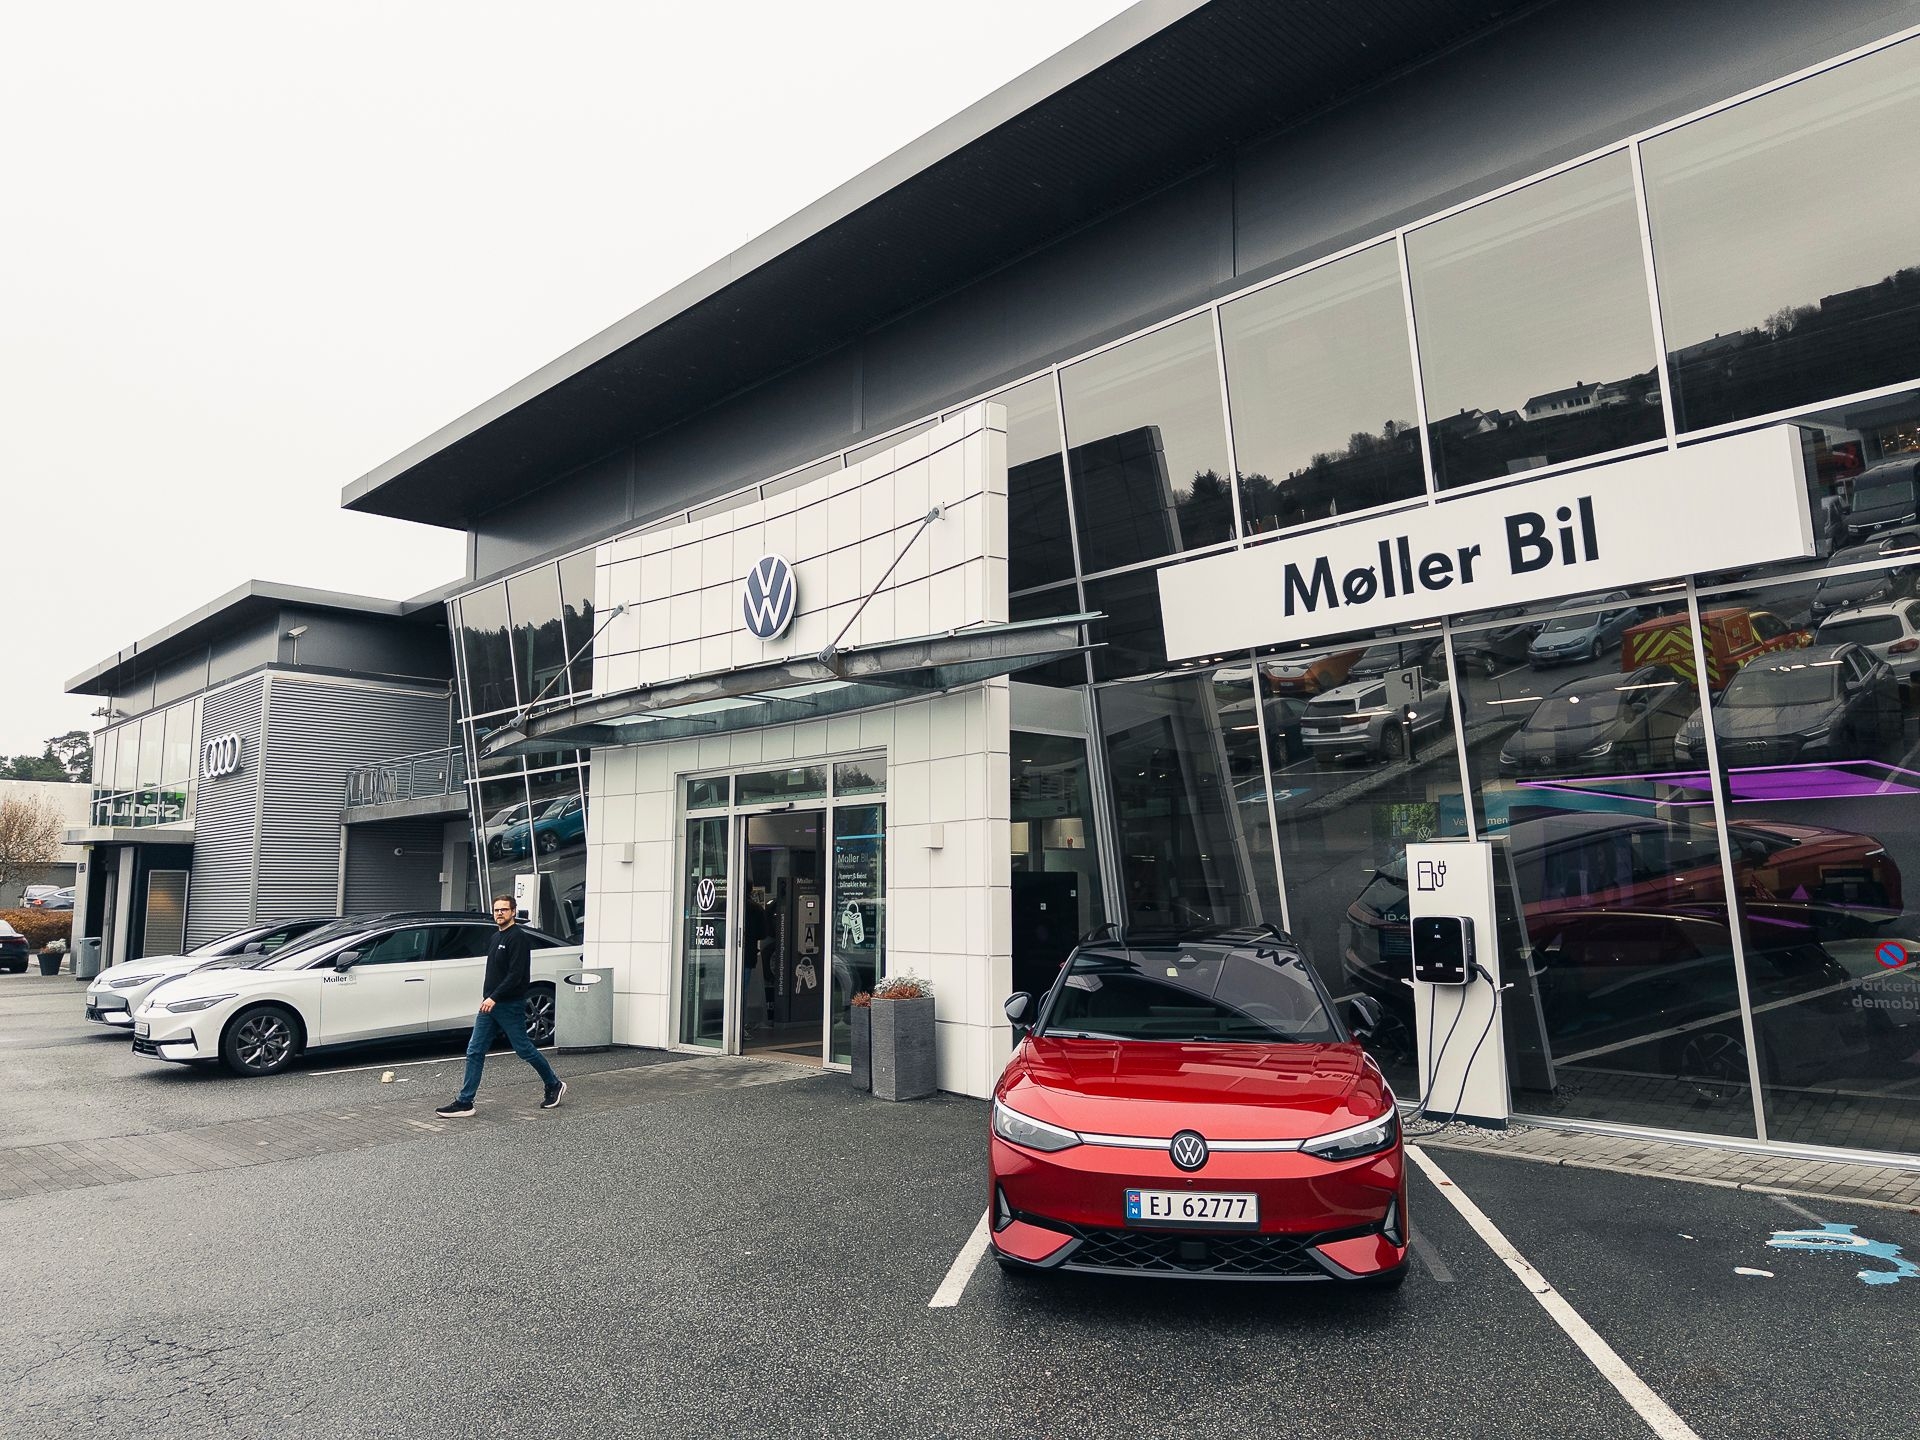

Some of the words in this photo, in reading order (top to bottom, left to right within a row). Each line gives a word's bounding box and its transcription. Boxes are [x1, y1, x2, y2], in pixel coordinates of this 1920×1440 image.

[1284, 535, 1481, 617] Møller
[1504, 495, 1599, 575] Bil
[1453, 817, 1509, 826] Velmen
[1384, 914, 1408, 922] ID.4
[696, 927, 704, 936] 75
[705, 925, 714, 936] ÅR
[1131, 1207, 1138, 1215] N
[1150, 1196, 1171, 1216] EJ
[1183, 1198, 1247, 1219] 62777
